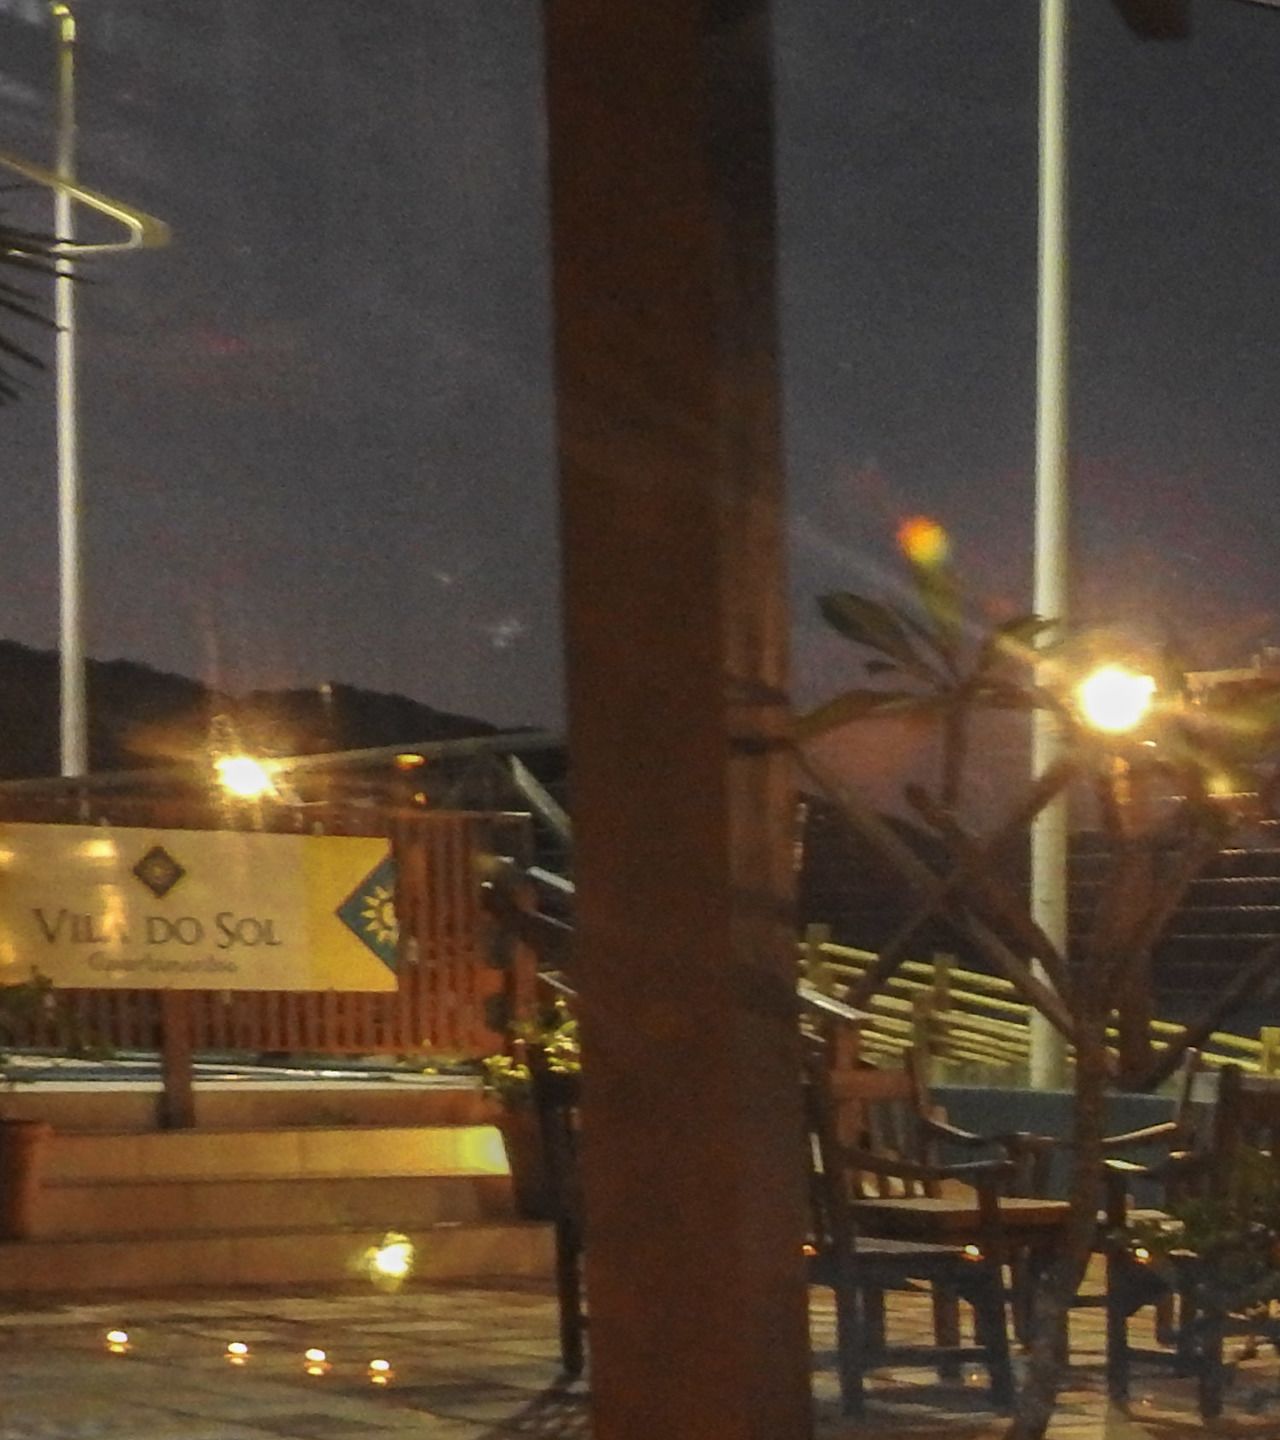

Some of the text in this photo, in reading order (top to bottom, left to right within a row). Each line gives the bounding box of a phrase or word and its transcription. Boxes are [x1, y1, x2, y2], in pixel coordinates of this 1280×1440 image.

[32, 907, 283, 949] VIL DO SOL
